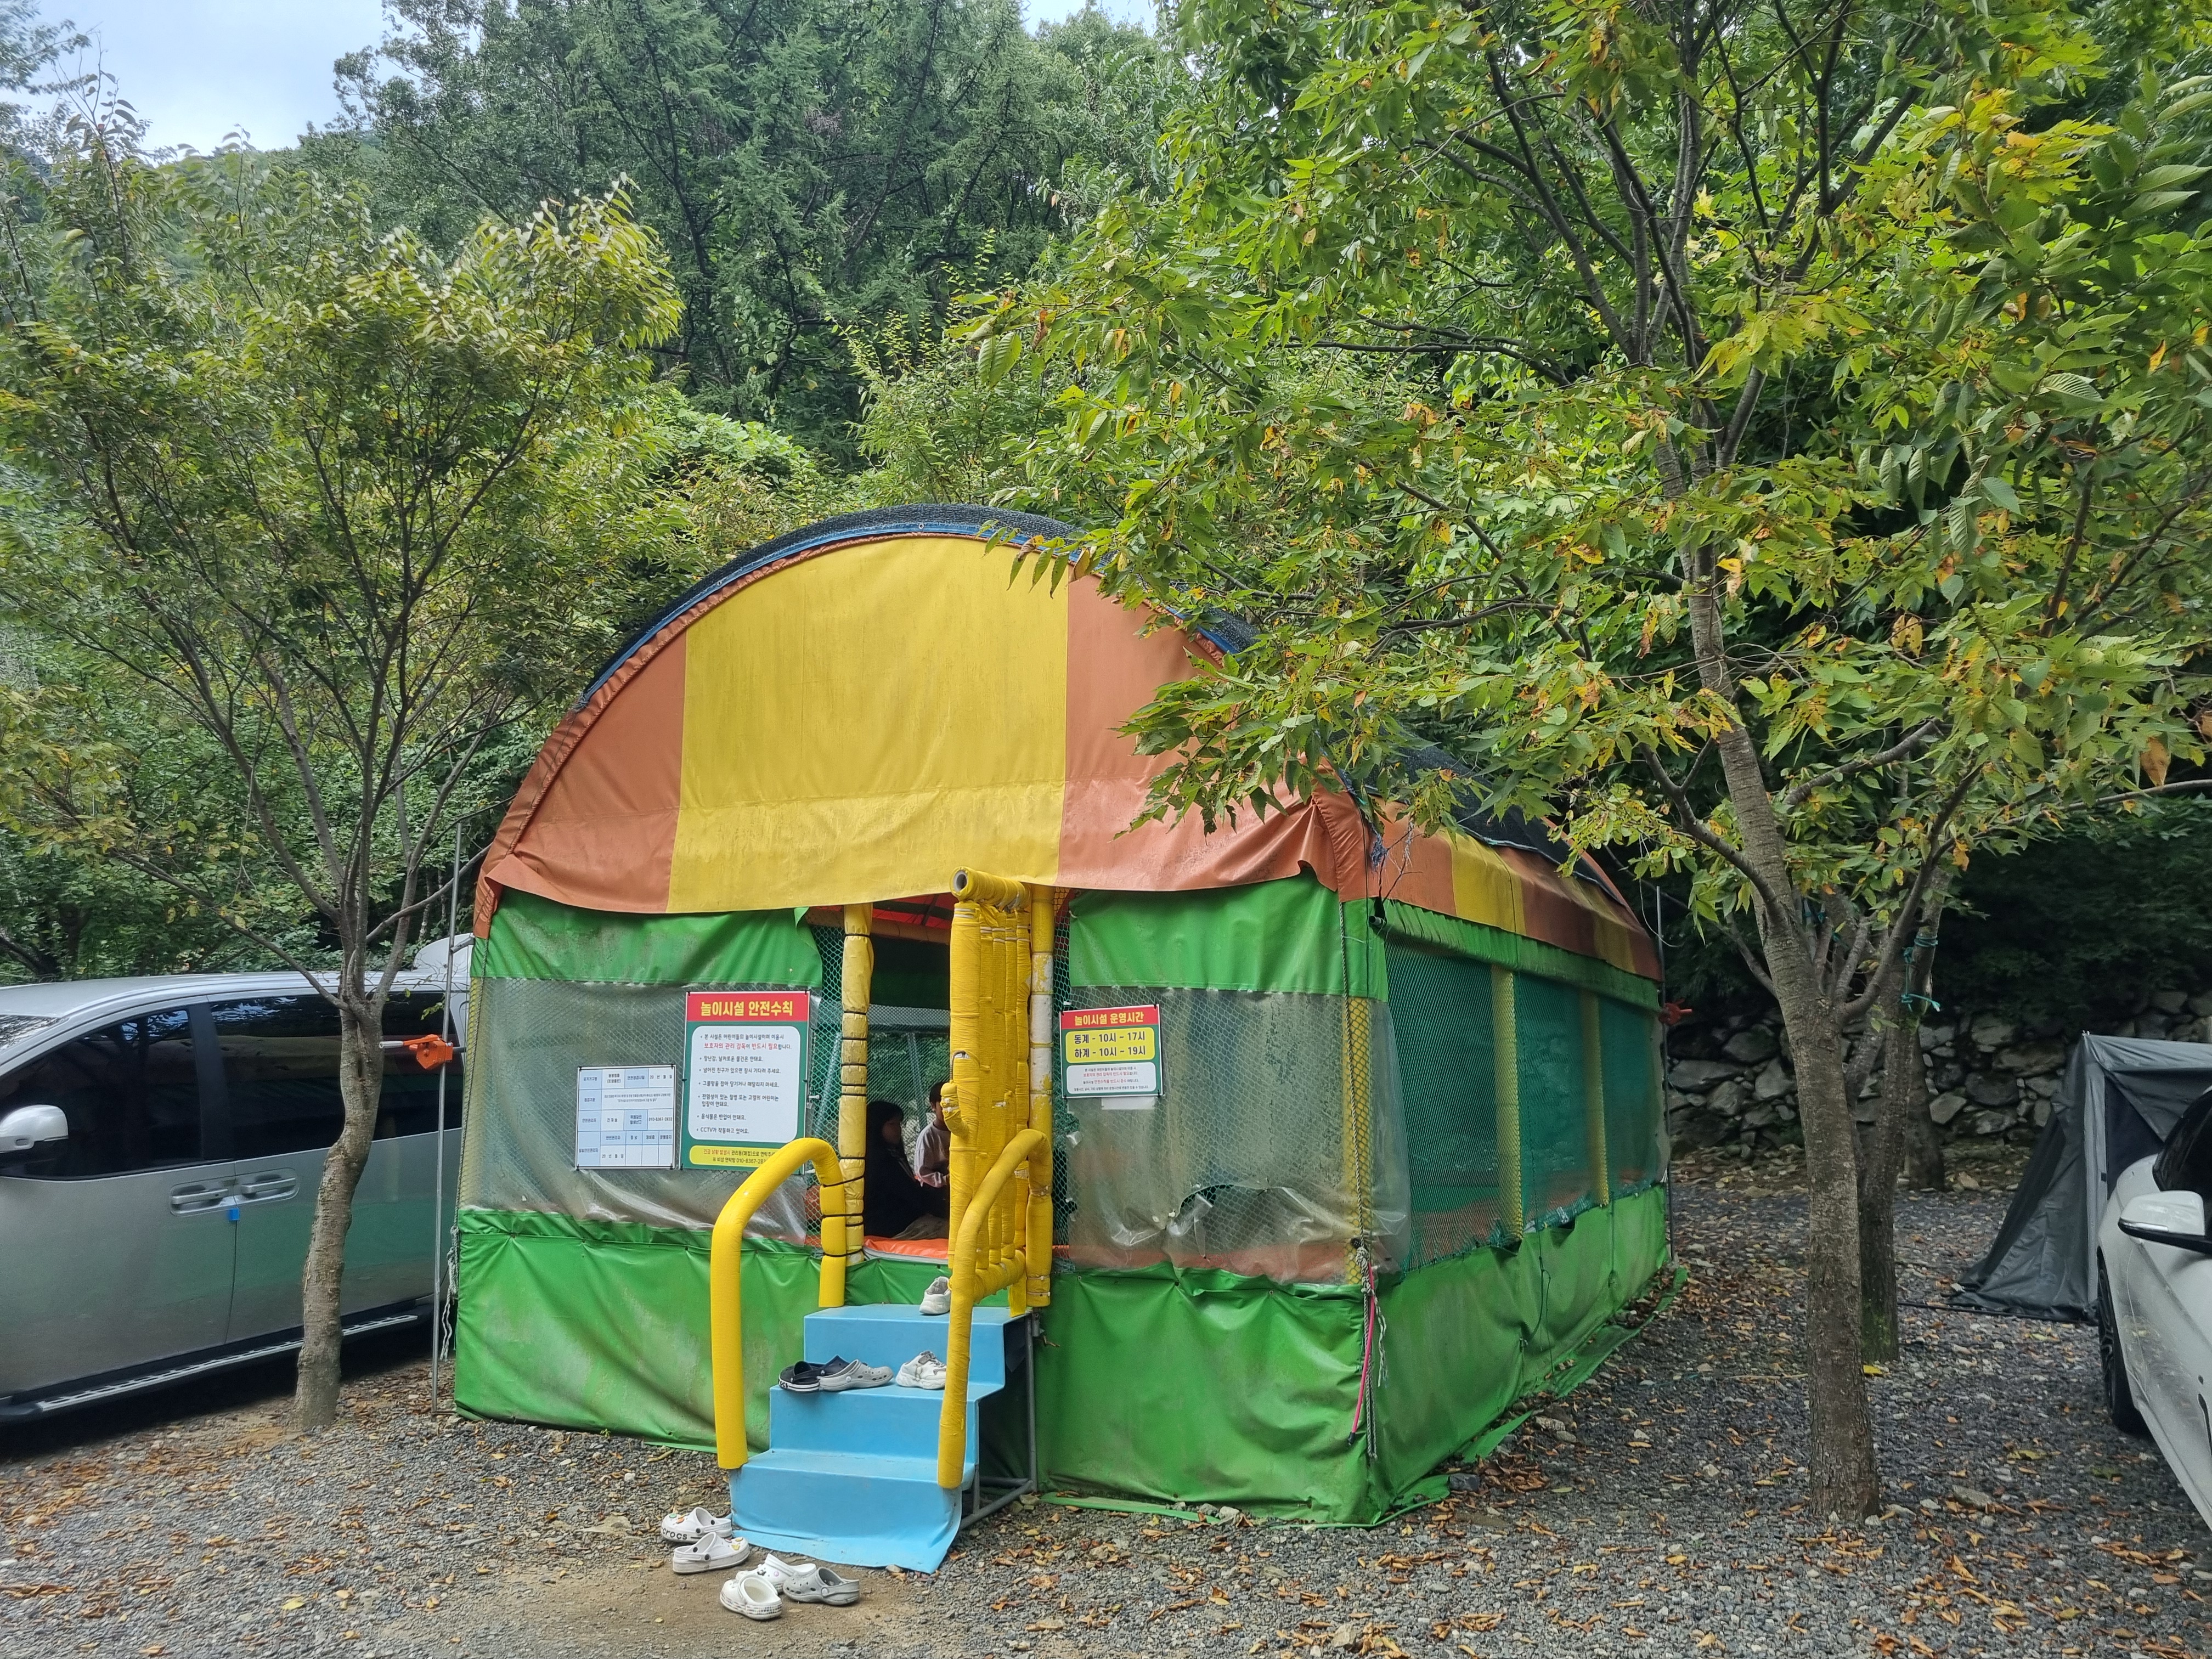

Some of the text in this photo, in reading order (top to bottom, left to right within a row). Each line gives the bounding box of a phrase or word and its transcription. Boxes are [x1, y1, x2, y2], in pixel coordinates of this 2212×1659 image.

[701, 1001, 793, 1017] 놀이시설 안전수칙
[1075, 1012, 1144, 1026] 놀이시설 운영시간
[1074, 1034, 1089, 1045] 동계
[1099, 1032, 1116, 1042] 10시
[1127, 1031, 1145, 1041] 17시
[1075, 1048, 1090, 1058] 하계
[1099, 1047, 1116, 1057] 10시
[1128, 1045, 1146, 1055] 19시
[663, 1528, 687, 1540] crocs
